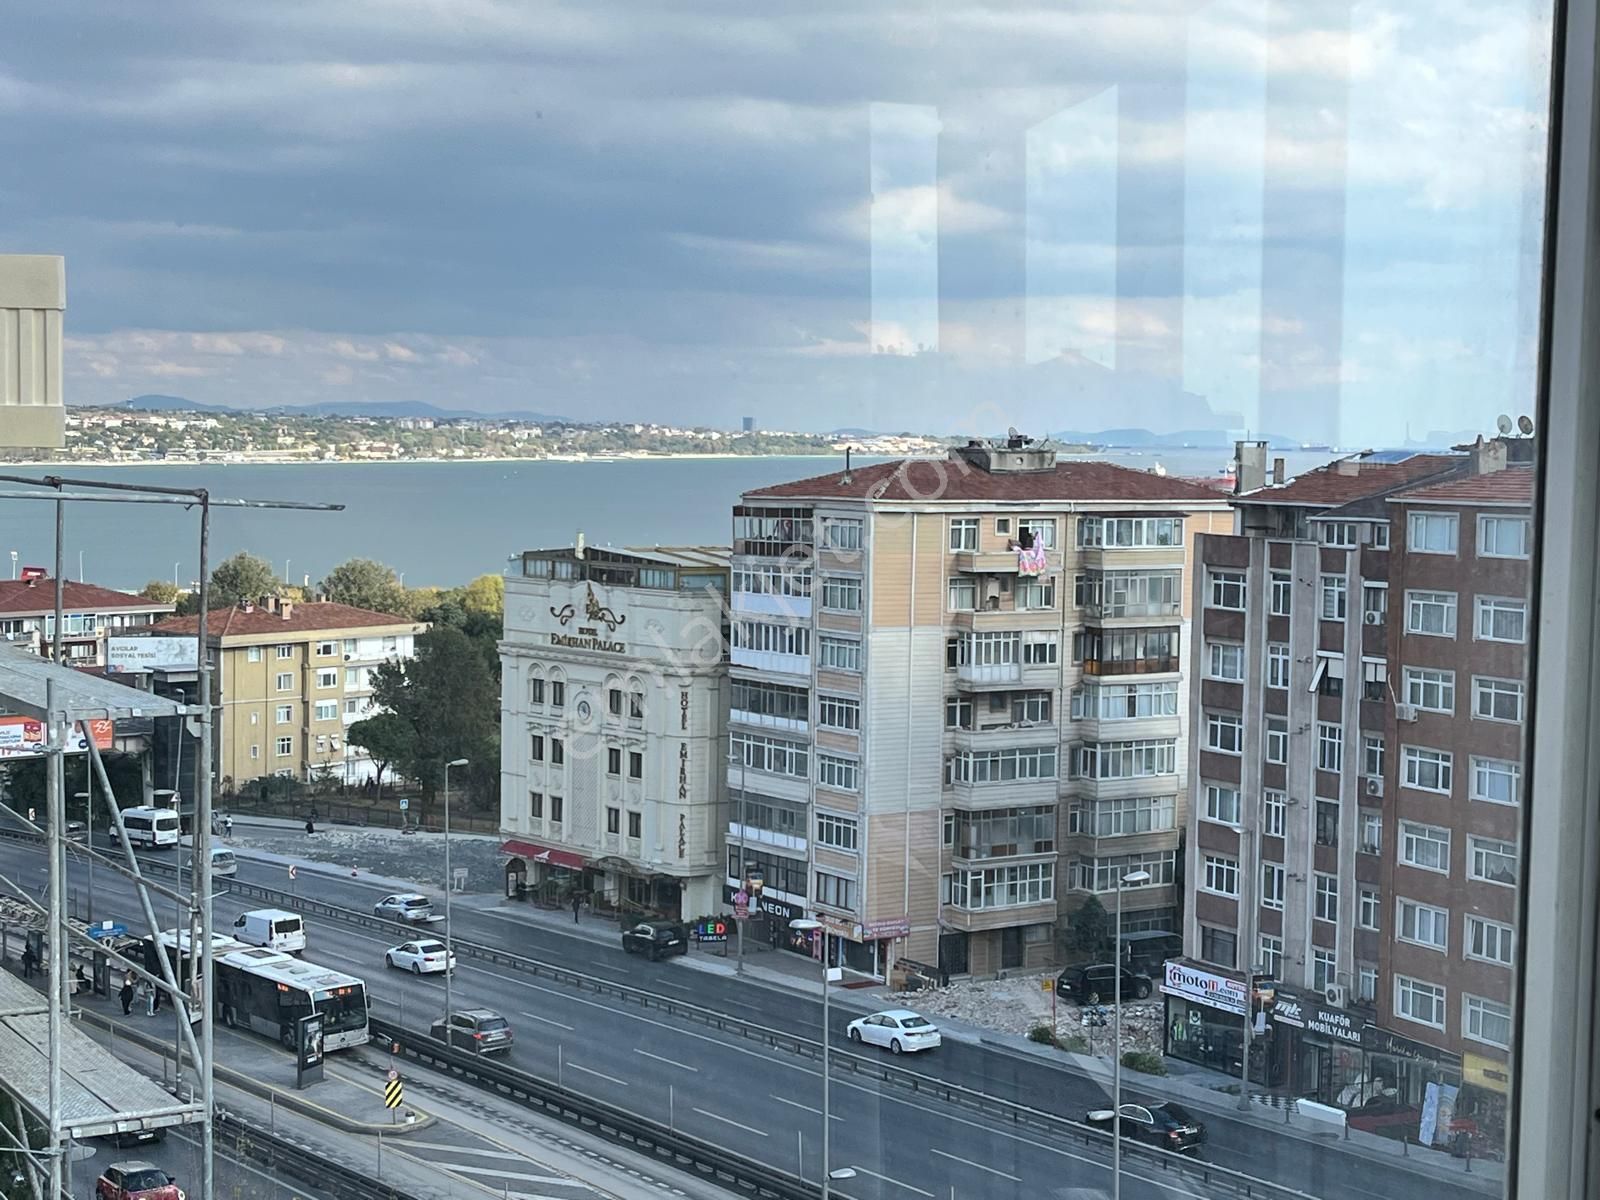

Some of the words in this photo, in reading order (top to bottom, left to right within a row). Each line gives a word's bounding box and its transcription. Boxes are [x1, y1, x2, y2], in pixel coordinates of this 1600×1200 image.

[592, 638, 625, 653] PALACE
[680, 692, 688, 730] HOTEL
[698, 923, 726, 935] LED
[1318, 1011, 1351, 1028] KUAFÖR
[1308, 1019, 1361, 1042] MOBİLYALARI
